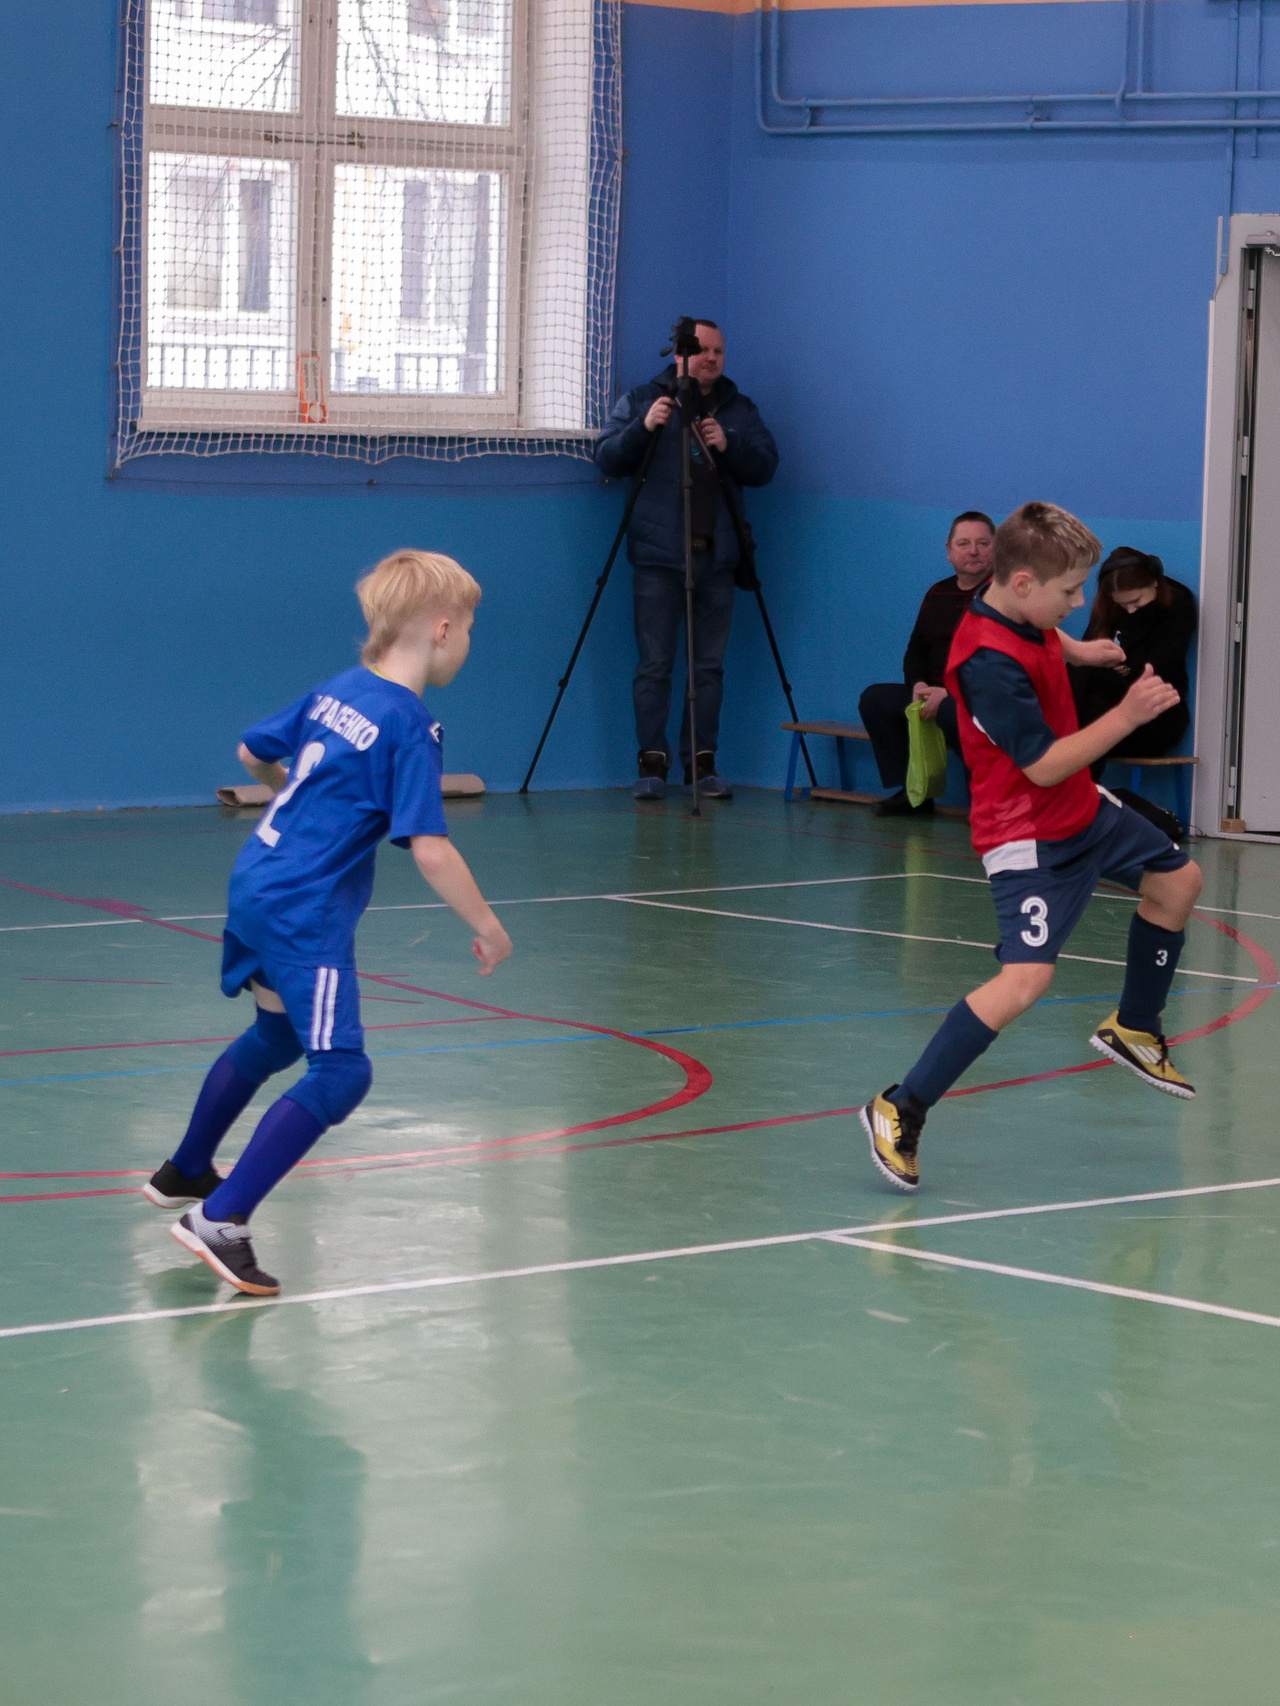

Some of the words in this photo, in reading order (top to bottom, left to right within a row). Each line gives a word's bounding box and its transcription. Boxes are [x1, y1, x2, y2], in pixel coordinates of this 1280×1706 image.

[256, 741, 326, 848] 2
[1020, 895, 1049, 948] 3
[1155, 949, 1169, 967] 3
